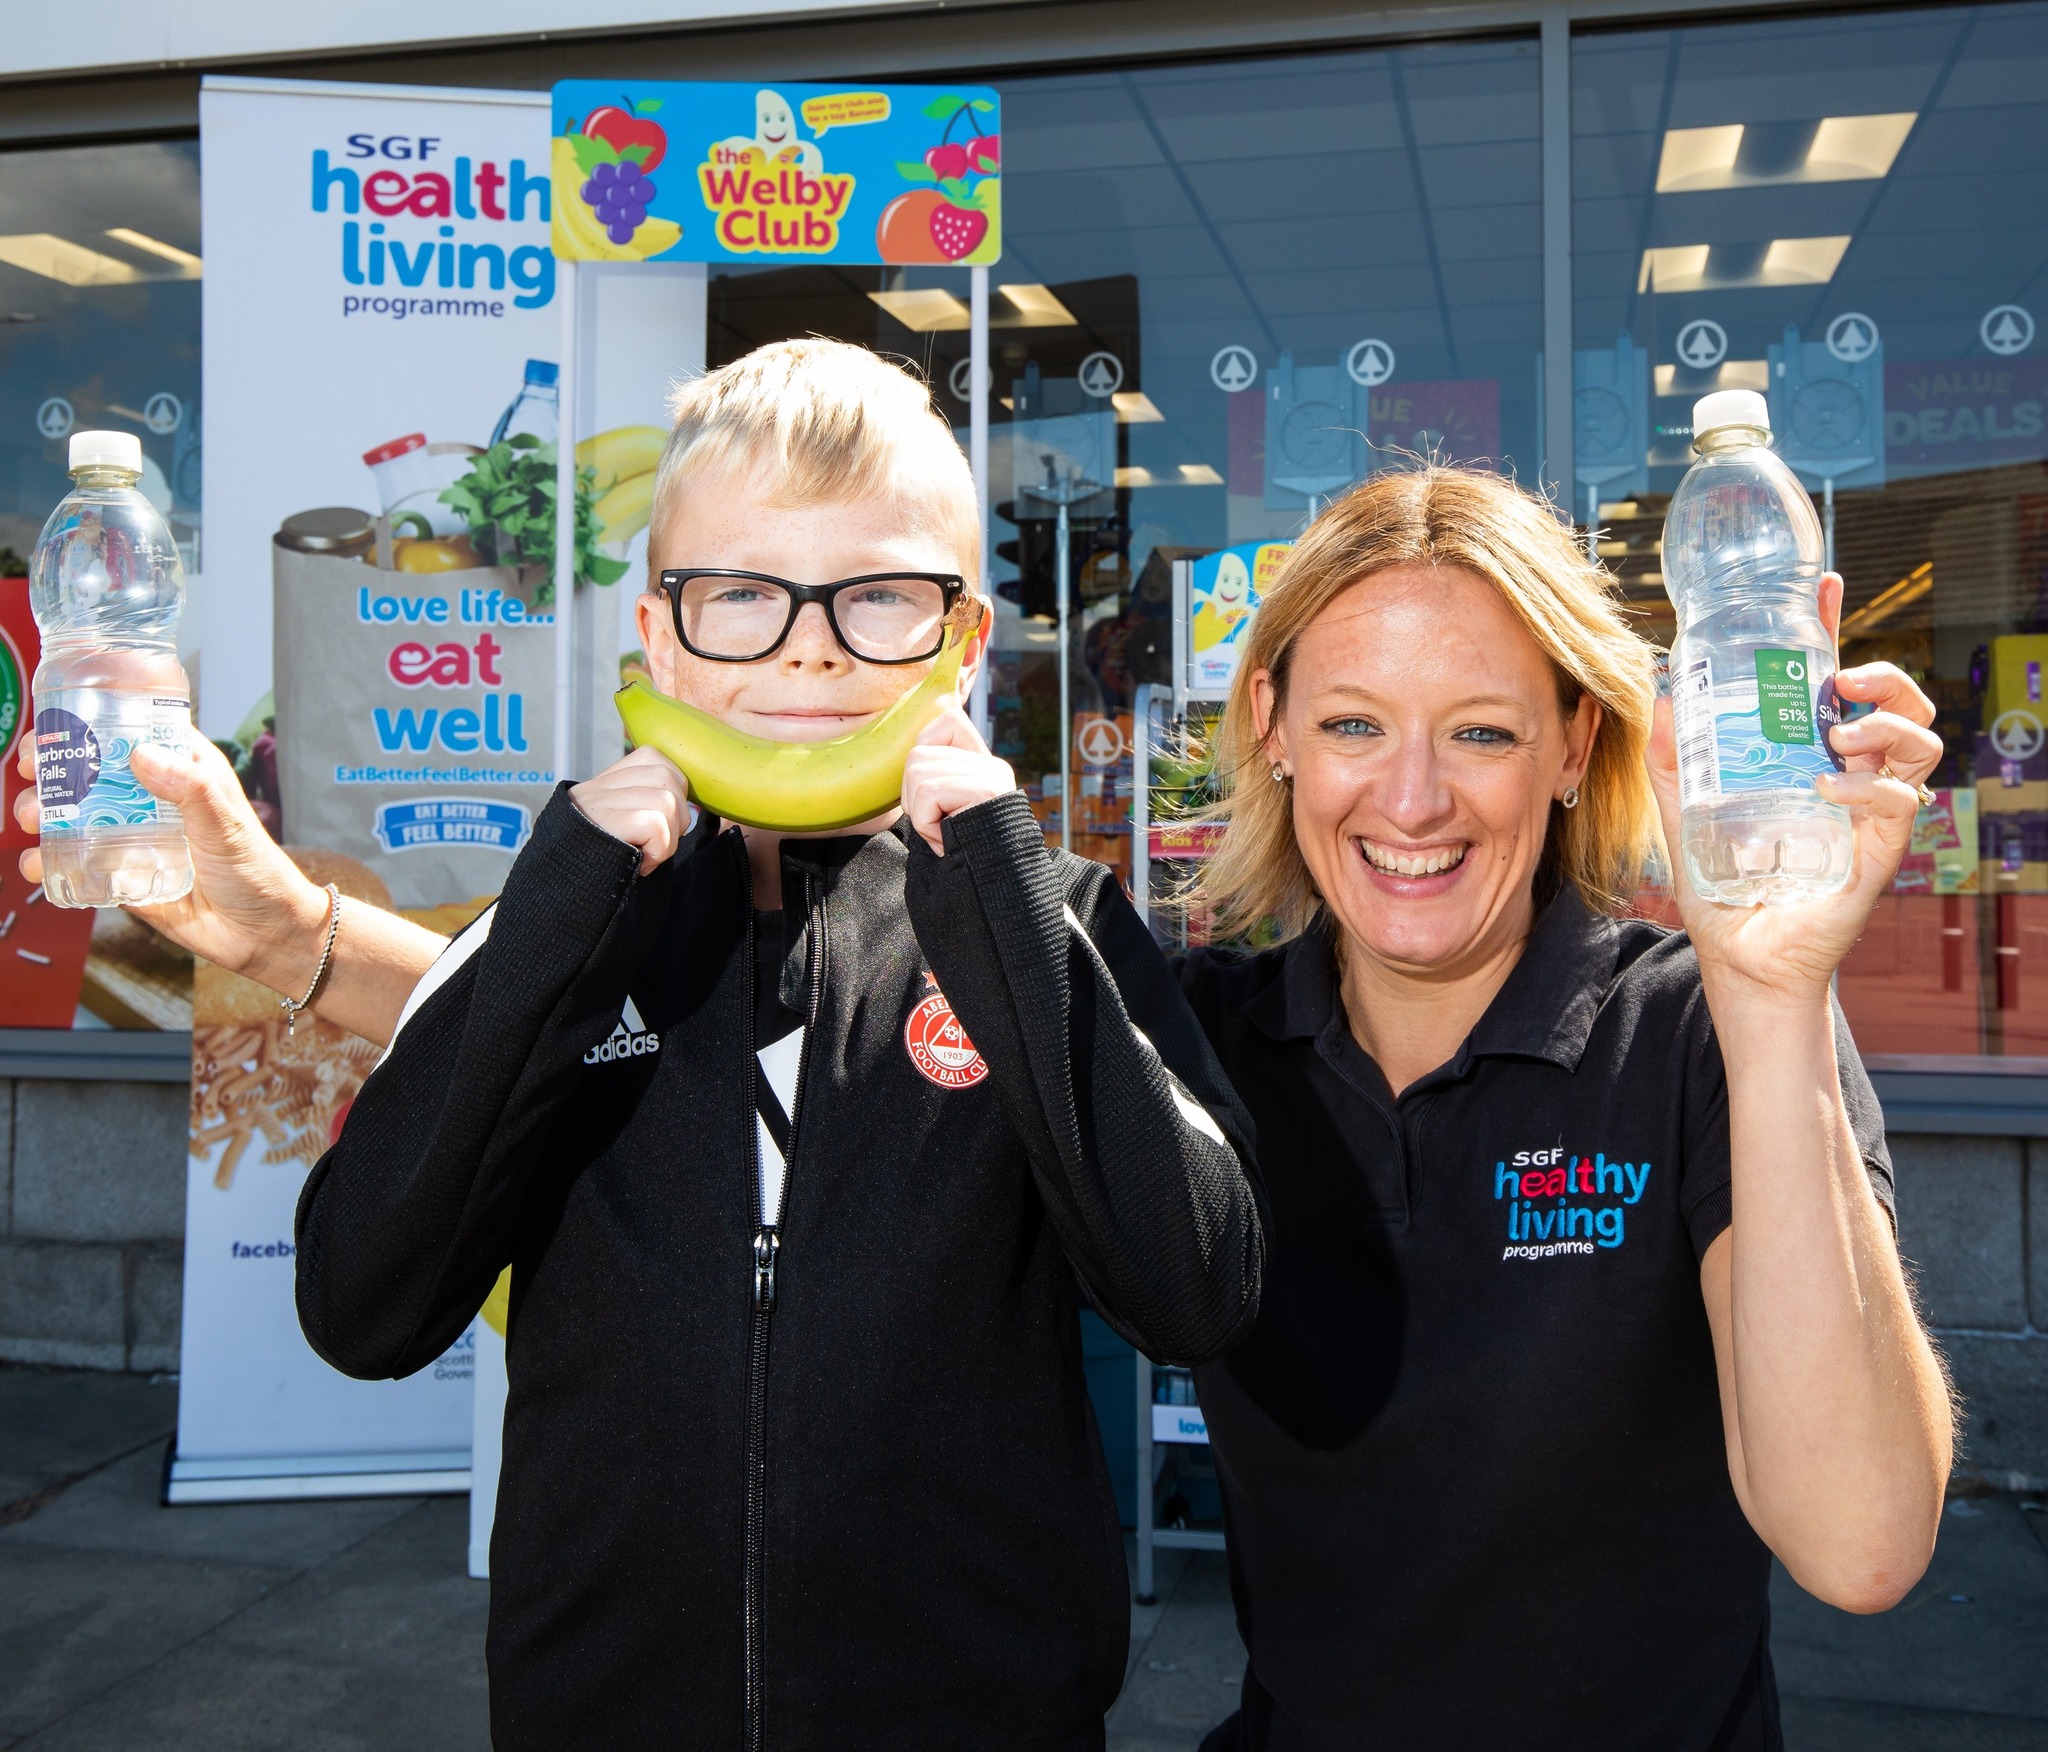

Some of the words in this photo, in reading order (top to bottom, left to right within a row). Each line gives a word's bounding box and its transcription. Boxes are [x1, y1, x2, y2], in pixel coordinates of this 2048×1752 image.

[346, 134, 441, 161] SGF
[716, 148, 752, 164] the
[311, 149, 551, 222] health
[704, 169, 849, 216] Welby
[722, 209, 832, 246] Club
[342, 221, 556, 310] living
[343, 295, 505, 319] programme
[1906, 373, 2012, 401] VALUE
[1884, 400, 2045, 447] DEALS
[358, 586, 449, 622] love
[460, 588, 556, 623] life...
[387, 632, 503, 687] eat
[1789, 692, 1805, 700] from
[372, 693, 528, 752] well
[1779, 708, 1808, 723] 51%
[1781, 724, 1809, 732] recycled
[1788, 732, 1810, 740] plastic
[41, 765, 67, 782] Falls
[335, 766, 556, 783] EatBetterFeelBetter.co.u
[55, 790, 74, 799] WATER
[44, 809, 65, 820] STILL
[414, 805, 438, 820] EAT
[441, 804, 488, 820] BETTER
[402, 823, 439, 844] FEEL
[442, 823, 503, 843] BETTER
[583, 1033, 660, 1065] adidas
[943, 1051, 963, 1061] 1903
[912, 1041, 970, 1084] FOOTBALL
[1512, 1148, 1564, 1167] SGF
[1494, 1153, 1651, 1204] healthy
[1508, 1197, 1625, 1248] living
[1503, 1242, 1594, 1261] programme
[1178, 1417, 1207, 1435] lov
